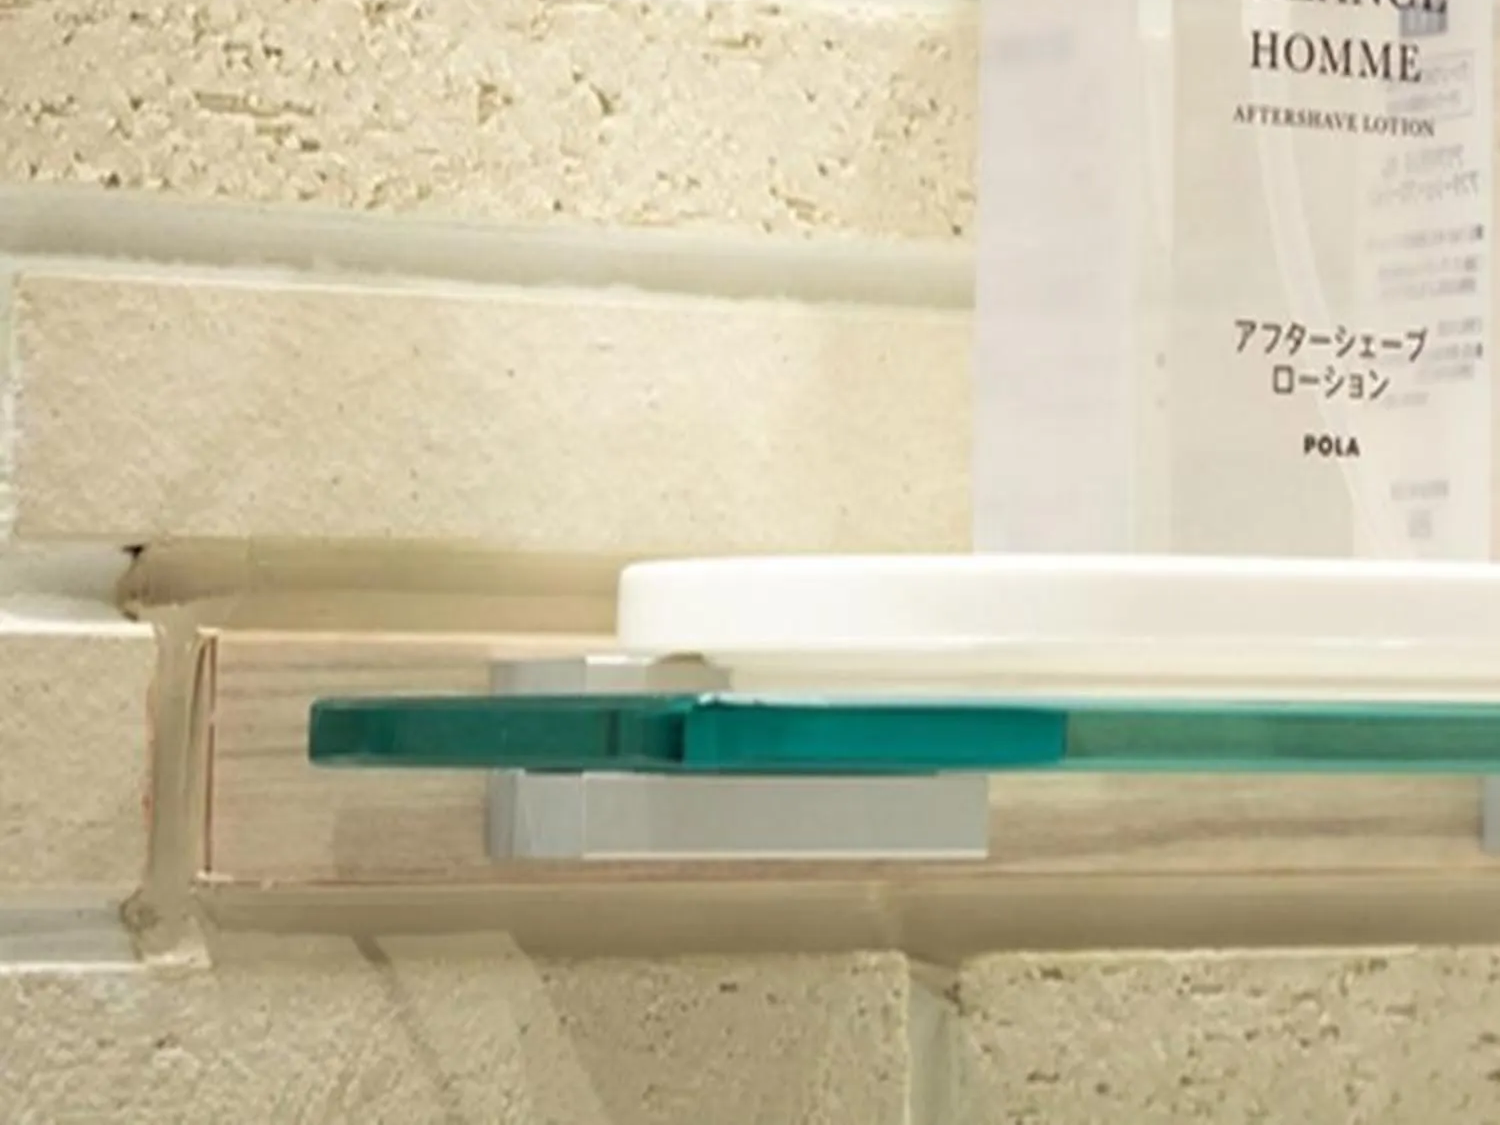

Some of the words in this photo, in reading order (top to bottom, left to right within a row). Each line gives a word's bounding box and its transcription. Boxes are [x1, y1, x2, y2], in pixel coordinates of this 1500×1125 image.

[1250, 29, 1422, 83] HOMME
[1233, 103, 1356, 133] AFTERSHAVE
[1362, 114, 1435, 138] LOTION
[1234, 319, 1428, 363] アフターシェーブ
[1273, 365, 1390, 400] ローション
[1304, 434, 1360, 457] POLA
